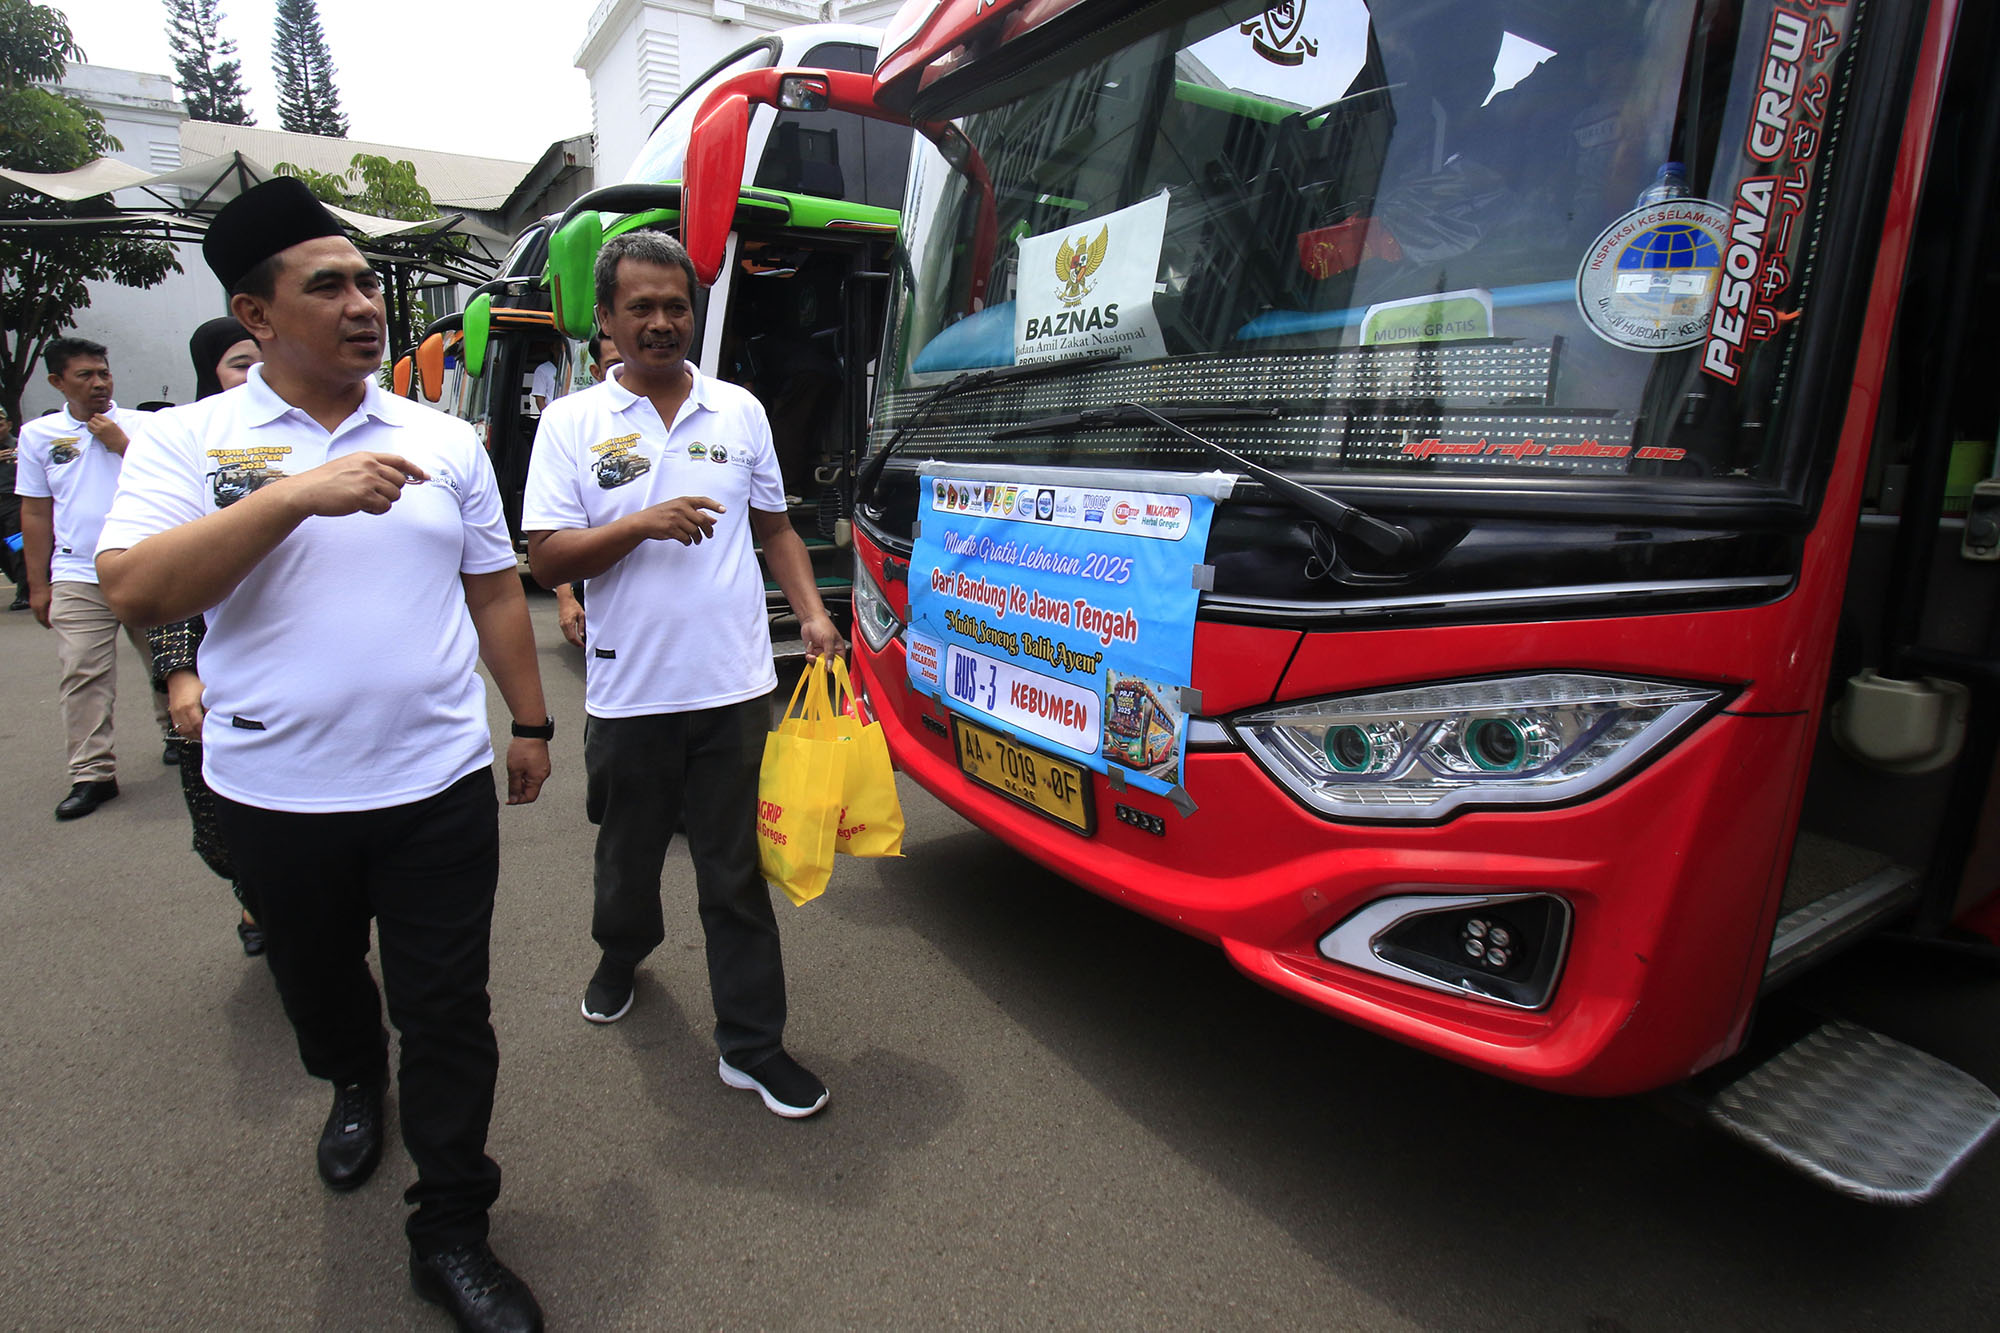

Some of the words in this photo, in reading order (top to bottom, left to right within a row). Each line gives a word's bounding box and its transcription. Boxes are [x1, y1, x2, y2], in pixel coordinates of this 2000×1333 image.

[1703, 178, 1778, 380] PESONA
[1749, 11, 1810, 159] CREW
[1590, 223, 1636, 270] INSPEKSI
[1025, 303, 1119, 341] BAZNAS
[1374, 326, 1420, 342] MUDIK
[1424, 319, 1476, 337] GRATIS
[1621, 320, 1668, 339] HUBDAT
[1036, 339, 1058, 352] Amil
[1060, 335, 1089, 349] Zakat
[1091, 327, 1147, 346] Nasional
[207, 449, 245, 458] MUDIK
[245, 446, 292, 455] SENENG
[218, 455, 250, 465] BALIK
[253, 453, 283, 461] AYEM
[240, 461, 266, 470] 2025
[1141, 517, 1158, 527] Herbal
[1158, 518, 1180, 530] Greges
[1146, 504, 1180, 518] MIXAGRIP
[944, 530, 977, 556] Mudik
[979, 536, 1018, 564] Gratis
[1018, 543, 1081, 575] Lebaran
[1081, 552, 1133, 584] 2025
[932, 568, 955, 594] Dari
[957, 573, 1006, 618] Bandung
[1009, 584, 1026, 613] Ke
[1029, 591, 1070, 625] Jawa
[1074, 600, 1137, 645] Tengah
[1021, 633, 1057, 666] Balik
[955, 652, 977, 703] BUS
[986, 664, 997, 711] 3
[1010, 679, 1087, 732] KEBUMEN
[965, 728, 984, 764] AA
[995, 740, 1037, 787] 7019
[761, 822, 787, 846] Greges
